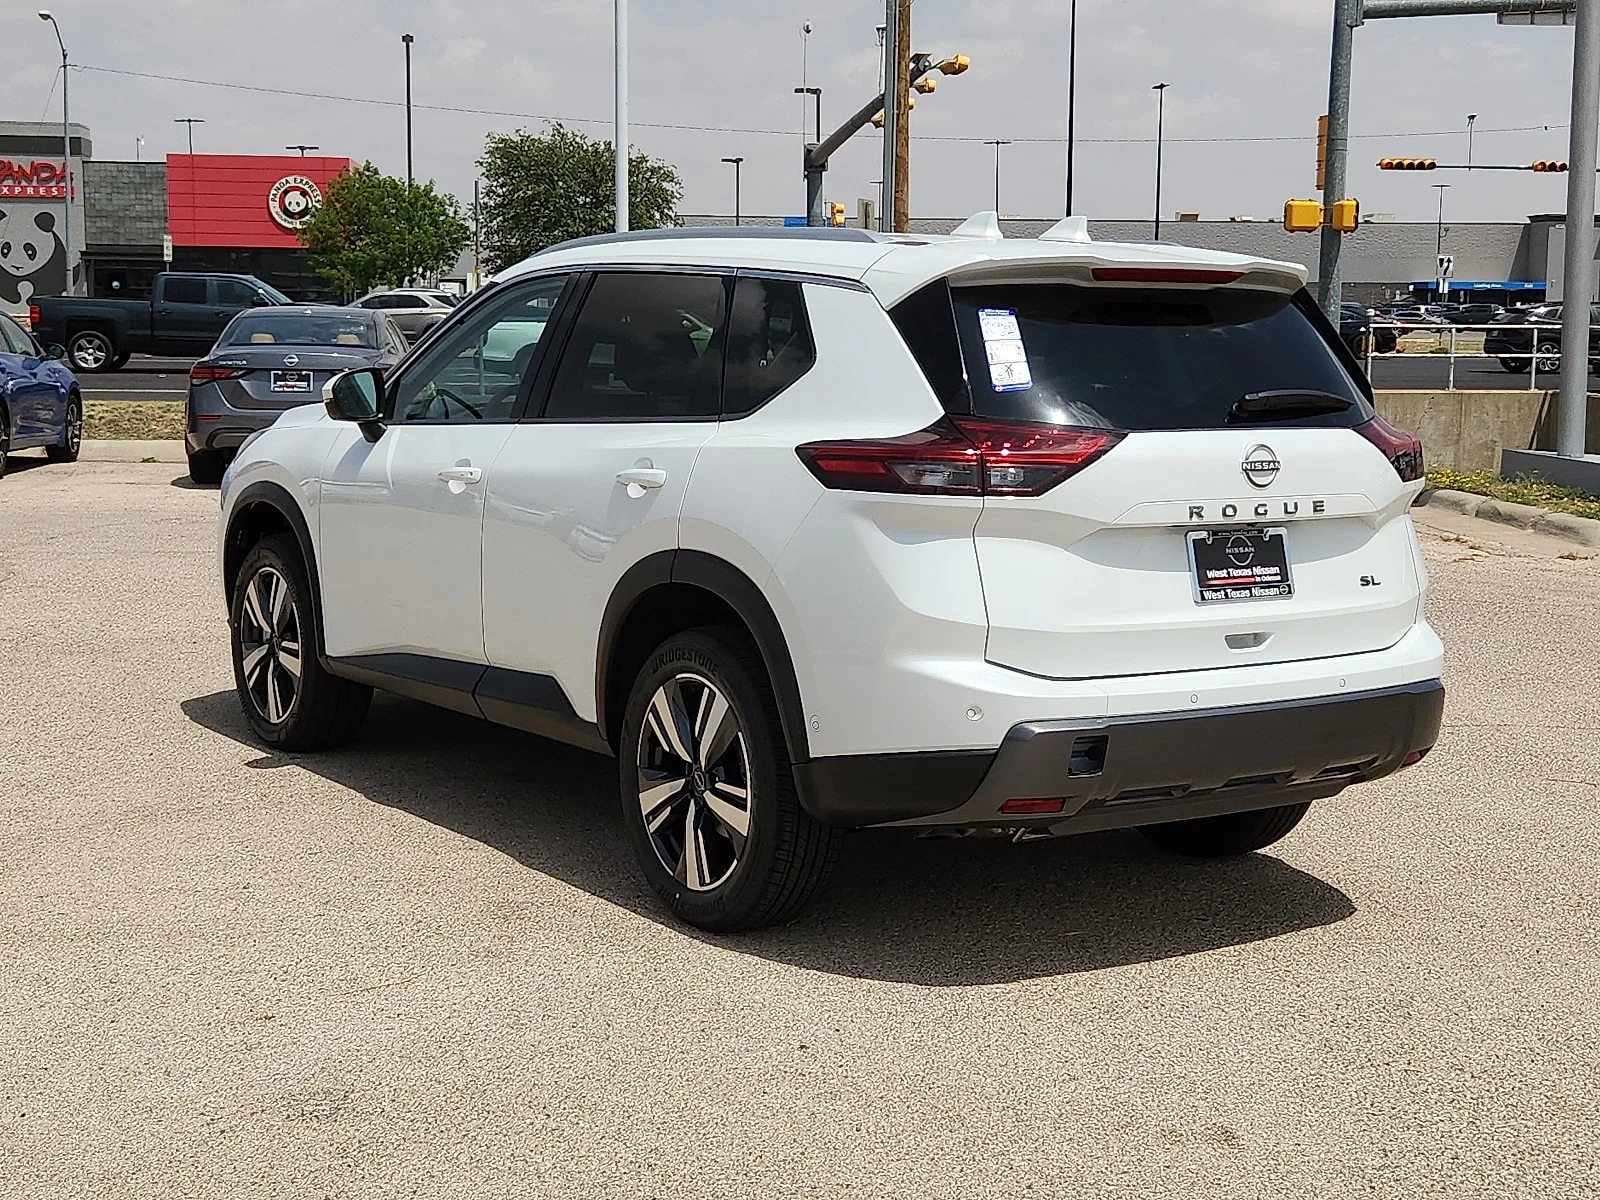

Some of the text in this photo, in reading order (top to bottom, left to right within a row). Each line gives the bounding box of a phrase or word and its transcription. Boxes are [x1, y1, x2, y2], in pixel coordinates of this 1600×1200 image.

[0, 186, 70, 196] XPRES
[270, 176, 322, 204] PANDA EXPRESS
[1242, 460, 1281, 472] NISSAN
[1188, 499, 1326, 521] ROGUE
[1206, 565, 1280, 579] West Texas Nissan
[1360, 575, 1381, 586] SL
[1203, 586, 1280, 600] West Texas Nissan
